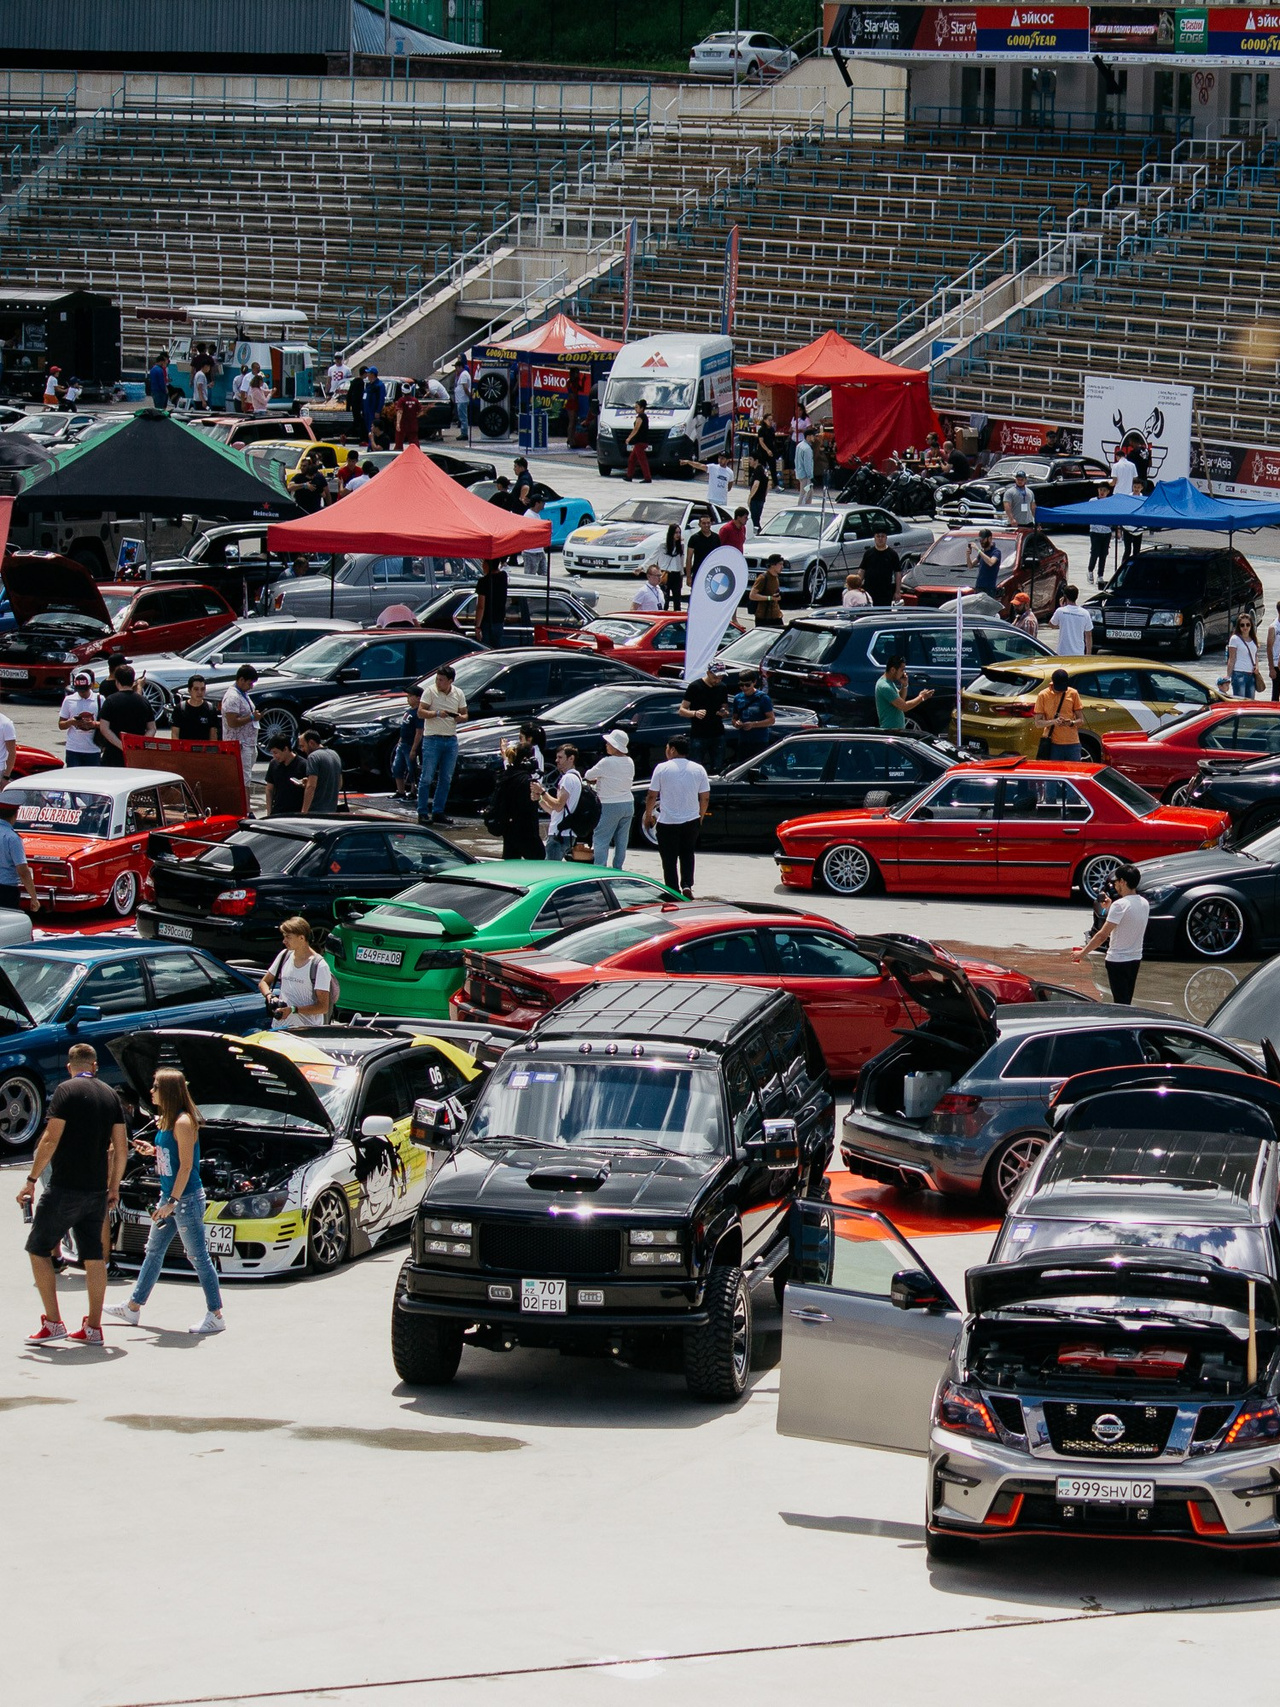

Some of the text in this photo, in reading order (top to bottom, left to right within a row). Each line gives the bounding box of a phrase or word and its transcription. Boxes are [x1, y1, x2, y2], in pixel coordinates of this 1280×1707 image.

[1021, 12, 1055, 24] ЭЙКОС
[1185, 21, 1204, 30] Castrol
[1007, 33, 1057, 47] GOODYEAR
[1180, 33, 1204, 43] EDGE
[486, 349, 518, 361] GOODYEAR
[557, 351, 617, 363] GOODYEA
[543, 373, 570, 388] ЭЙКО
[1200, 457, 1214, 467] Sar
[1266, 463, 1280, 475] Star
[253, 510, 280, 518] Heineken
[17, 806, 81, 824] INDER SURPRISE
[362, 949, 390, 962] 649FFA
[390, 953, 401, 964] 08
[429, 1065, 443, 1085] 06
[210, 1225, 232, 1239] 612
[210, 1241, 231, 1253] FWA
[539, 1281, 565, 1295] 707
[523, 1296, 562, 1310] 02 FBI
[1072, 1481, 1128, 1497] 999SHV
[1133, 1484, 1152, 1499] 02
